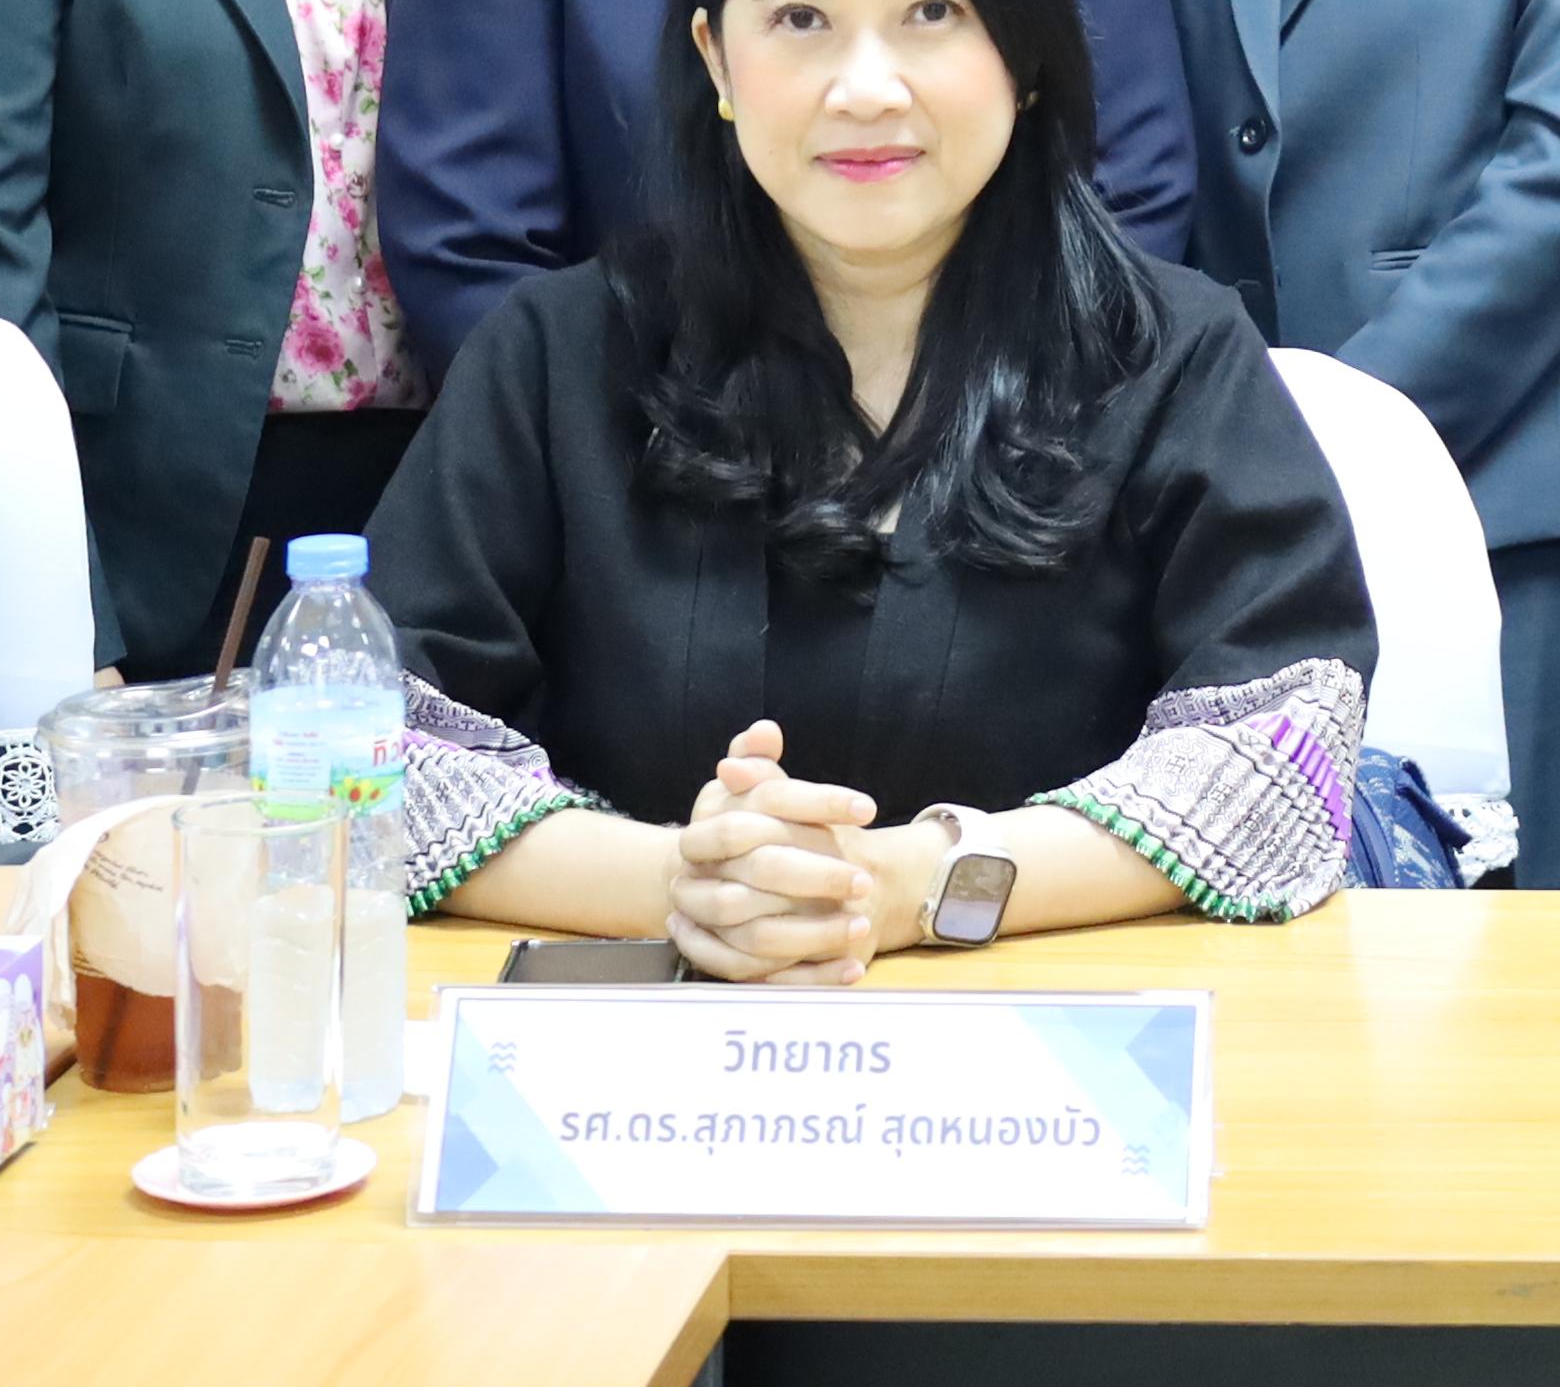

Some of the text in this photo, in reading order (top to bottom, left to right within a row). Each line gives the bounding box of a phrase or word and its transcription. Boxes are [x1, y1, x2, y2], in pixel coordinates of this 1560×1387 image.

[724, 1030, 891, 1073] วิทยากร
[560, 1103, 1101, 1158] รศ.ดร.สุภาภรณ์ สุดหนองบัว
